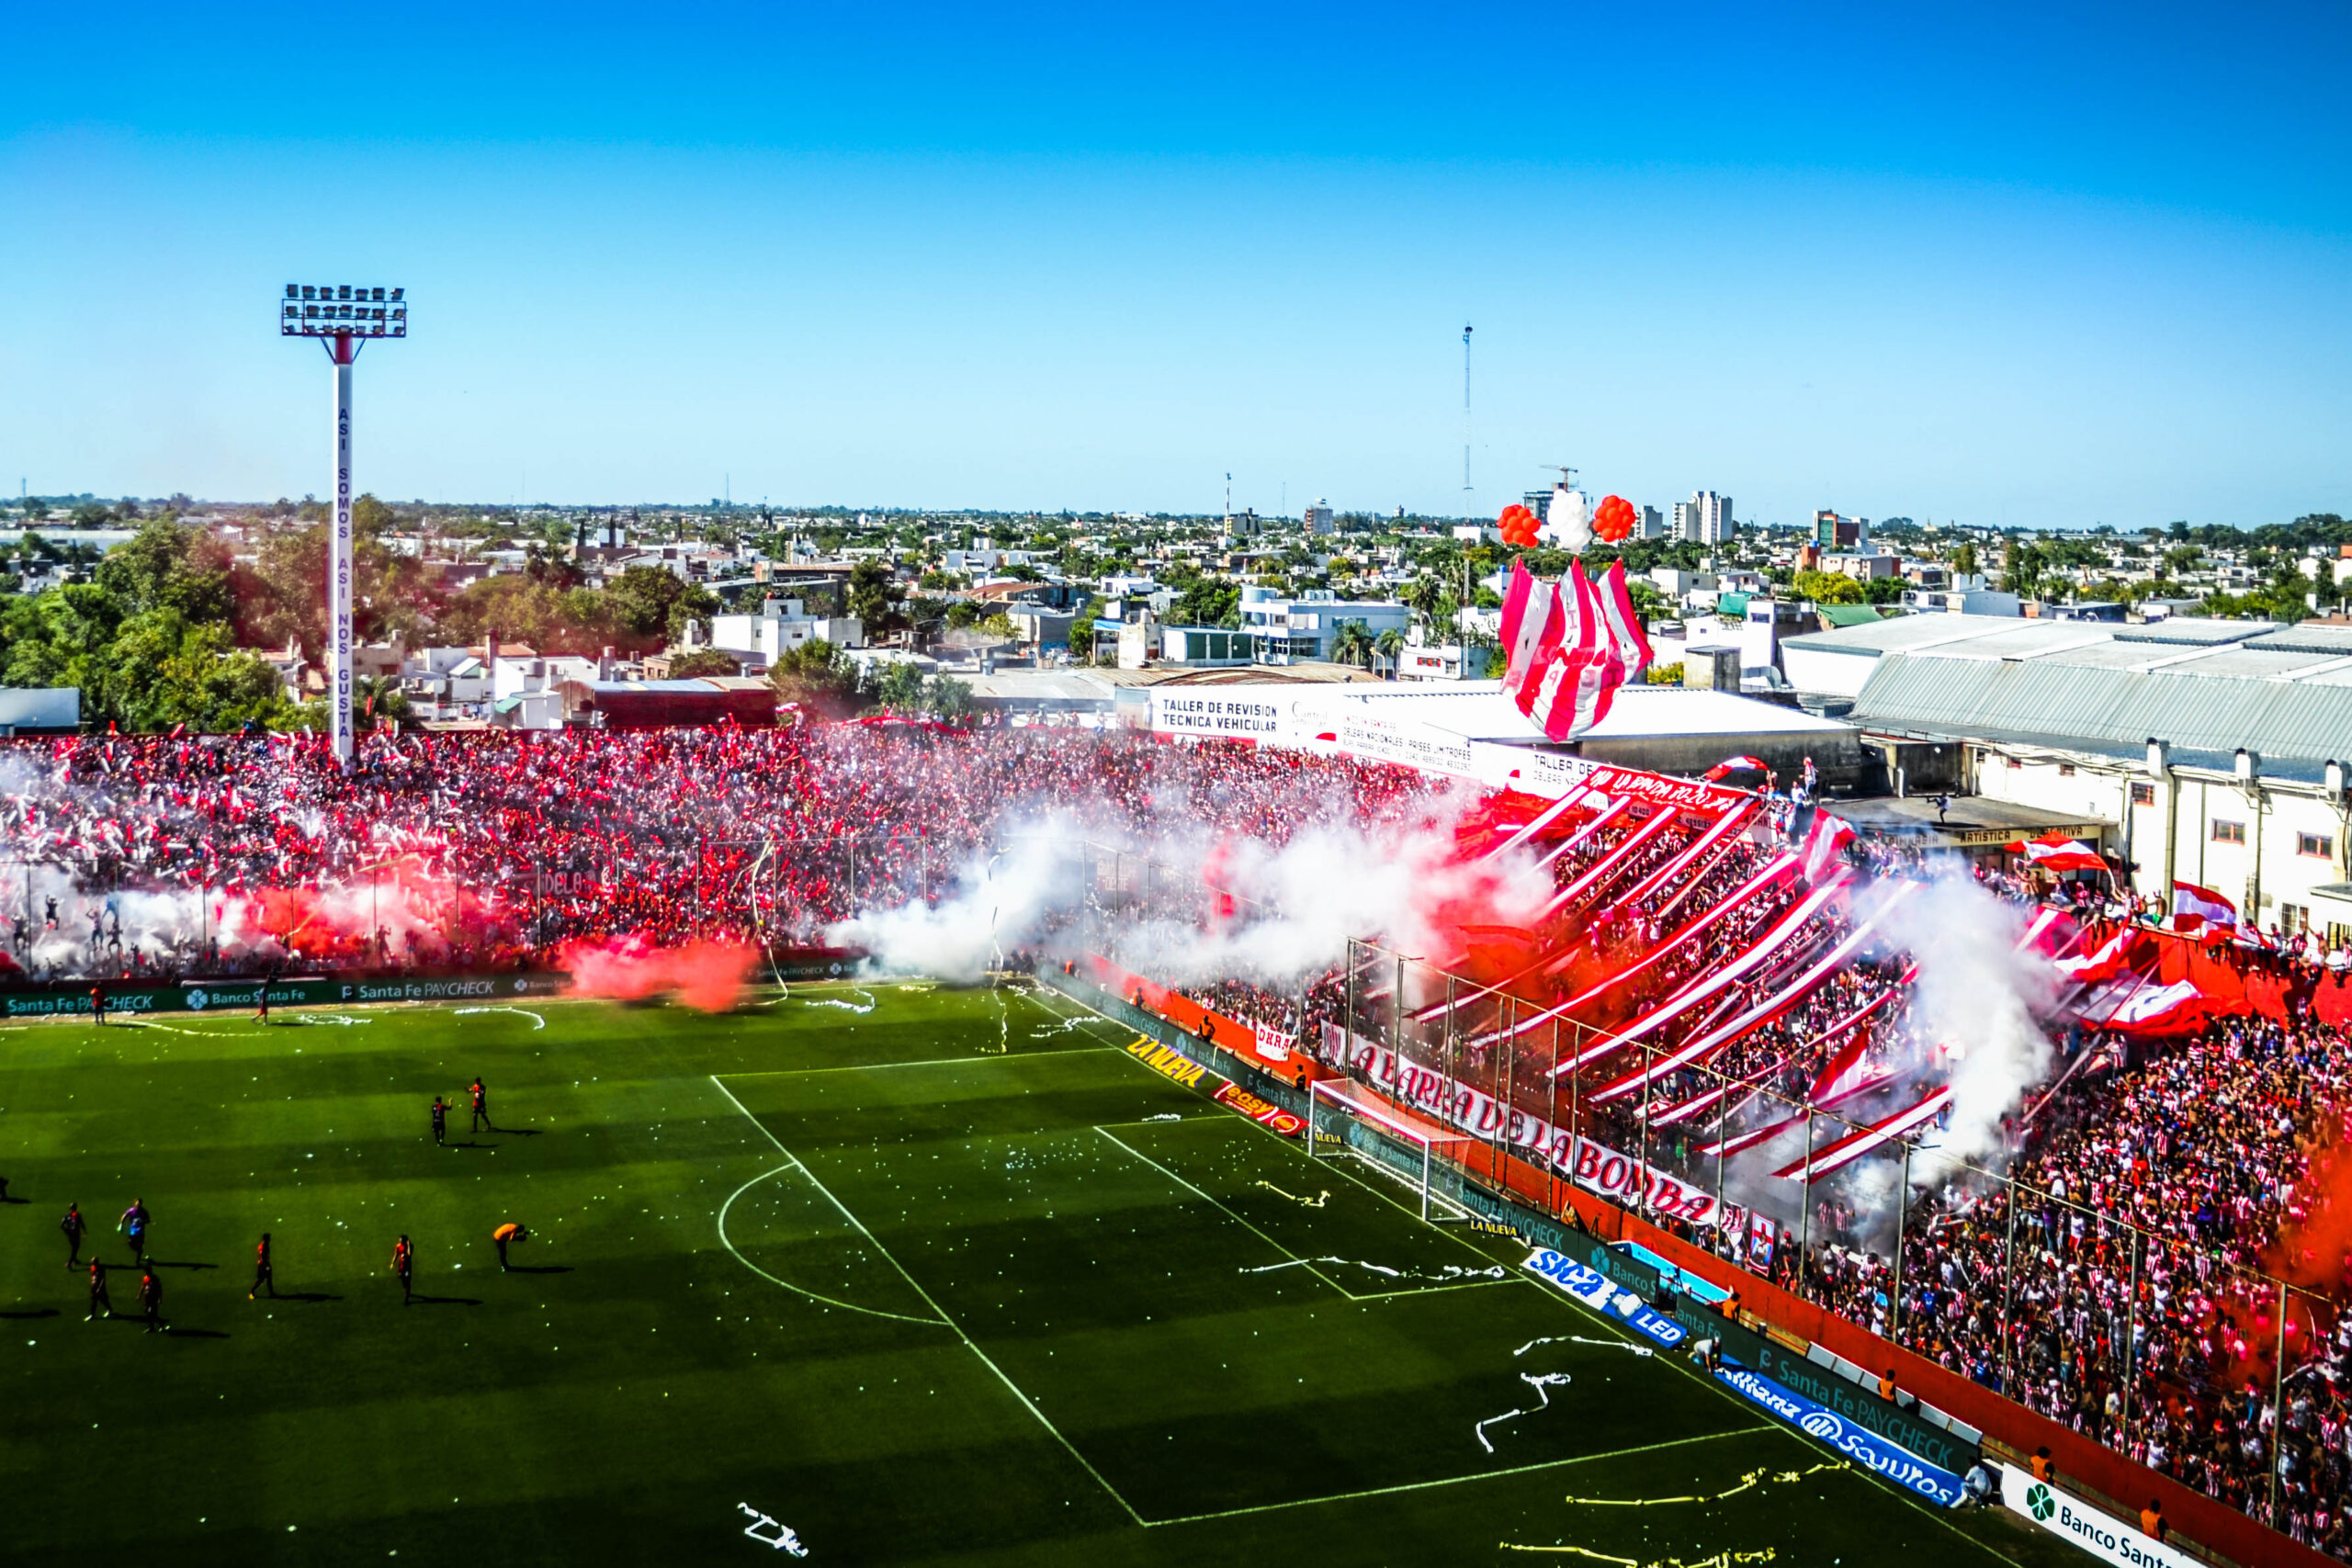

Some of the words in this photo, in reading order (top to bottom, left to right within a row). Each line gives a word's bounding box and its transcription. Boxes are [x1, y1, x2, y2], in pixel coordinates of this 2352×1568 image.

[338, 409, 349, 450] ASI
[338, 468, 350, 538] SOMOS
[338, 558, 349, 599] ASI
[338, 615, 349, 654] NOS
[339, 668, 350, 738] GUSTA
[1163, 699, 1204, 713] TALLER
[1208, 702, 1222, 714] DE
[1227, 704, 1277, 717] REVISION
[1163, 714, 1212, 728] TECNICA
[1216, 717, 1277, 733] VEHICULAR
[1534, 754, 1573, 772] TALLER
[1579, 762, 1593, 776] DE
[1960, 830, 2011, 844] ARTISTICA
[8, 998, 54, 1013] Santa
[57, 997, 75, 1011] Fe
[78, 995, 154, 1011] PACHECK
[212, 993, 251, 1004] Banco
[254, 990, 288, 1002] Snta
[291, 988, 306, 1000] Fe
[359, 985, 402, 998] Santa
[405, 984, 422, 997] Fe
[424, 981, 495, 996] PAYCHECK
[1126, 1032, 1160, 1059] LA
[1145, 1042, 1207, 1089] NUEVA
[1227, 1087, 1275, 1115] easy
[1256, 1079, 1279, 1103] Santa
[1279, 1090, 1291, 1108] Fe
[1315, 1133, 1342, 1145] NUEVA
[1575, 1142, 1715, 1223] BOMBA
[1457, 1182, 1489, 1214] Santa
[1490, 1200, 1504, 1219] Fe
[1505, 1207, 1564, 1251] PAYCHECK
[1471, 1220, 1484, 1232] LA
[1485, 1223, 1518, 1237] NUEVA
[1612, 1261, 1648, 1292] Banco
[1635, 1312, 1682, 1343] LED
[1779, 1360, 1830, 1401] Santa
[1832, 1386, 1854, 1415] Fe
[1857, 1397, 1954, 1470] PAYCHECK
[2060, 1506, 2116, 1551] Banco
